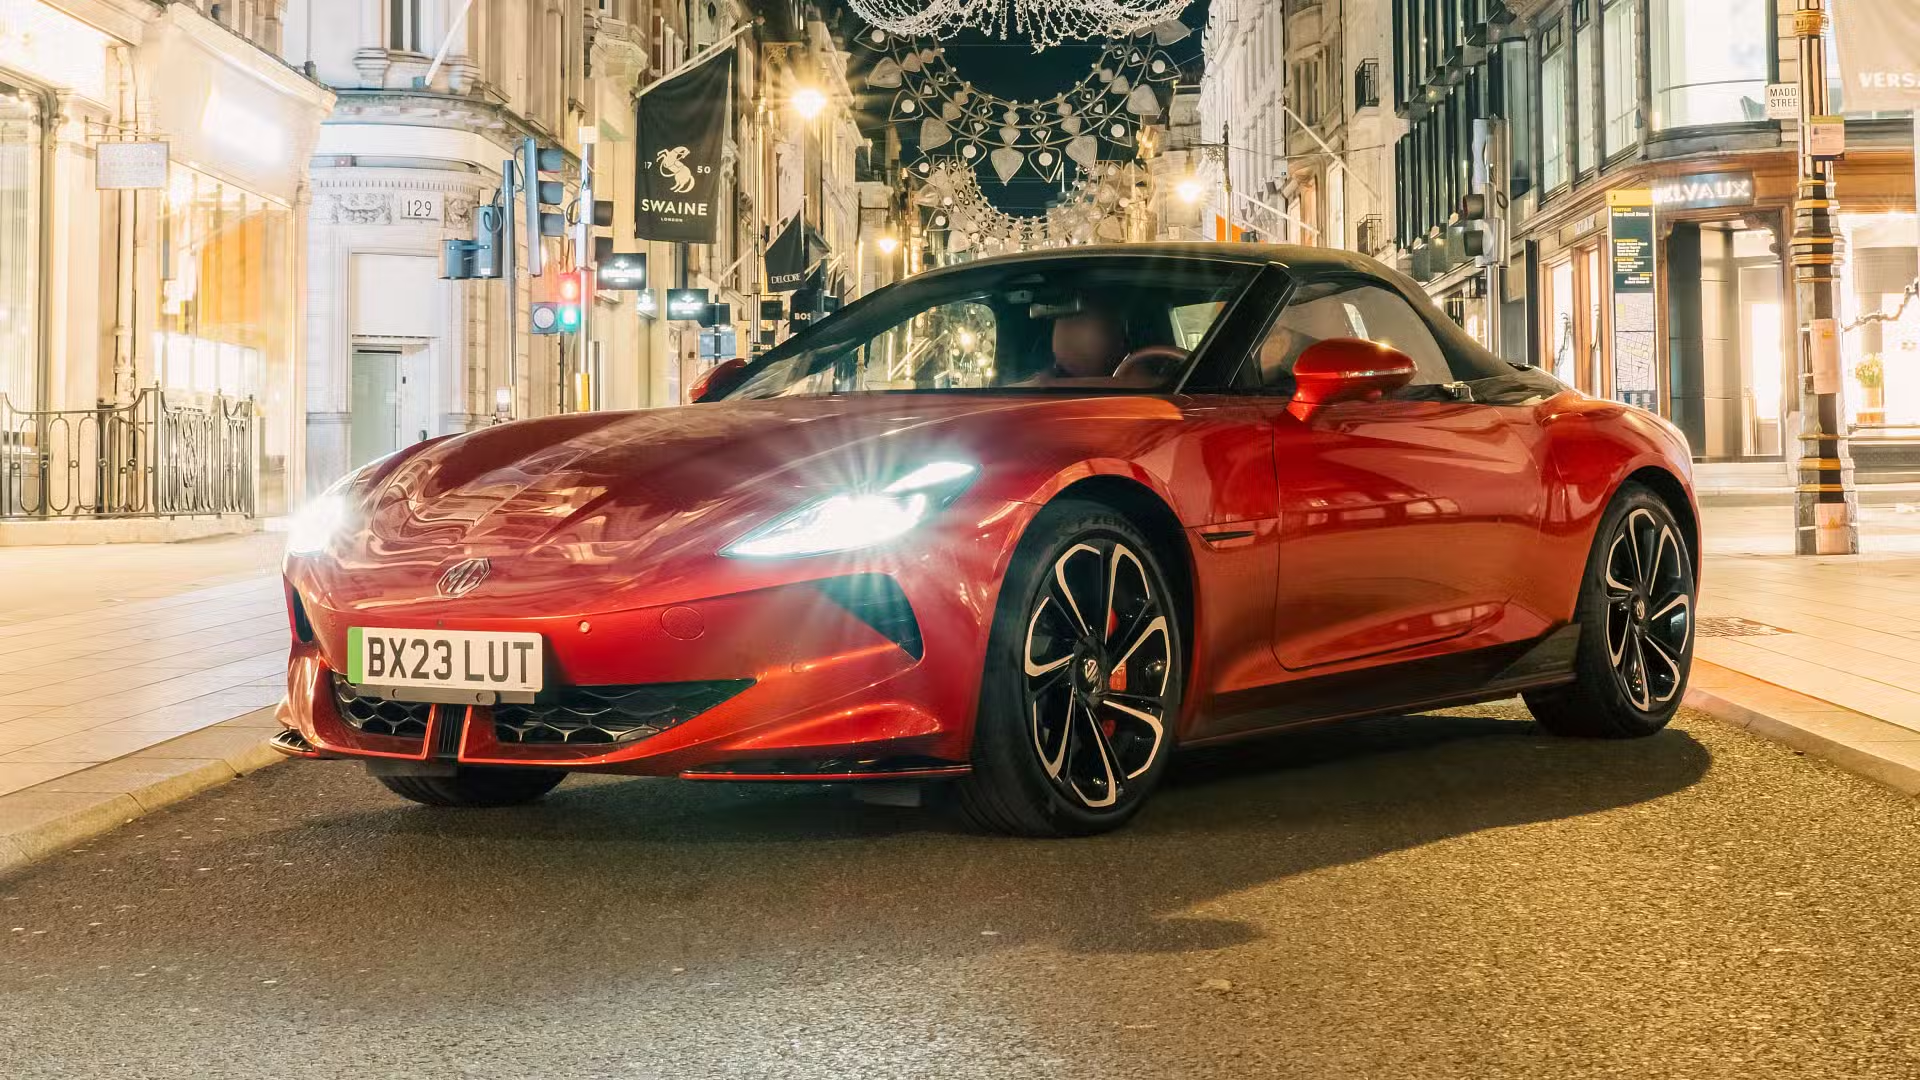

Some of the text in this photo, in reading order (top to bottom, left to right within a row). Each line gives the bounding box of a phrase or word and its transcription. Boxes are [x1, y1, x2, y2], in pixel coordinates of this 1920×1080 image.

[1858, 71, 1920, 88] VERS
[1769, 87, 1797, 97] MADD
[1770, 98, 1798, 108] STREE
[697, 165, 711, 174] 50
[407, 199, 432, 217] 129
[641, 198, 708, 216] SWAINE
[441, 559, 487, 594] MG
[367, 636, 535, 684] BX23 LUT
